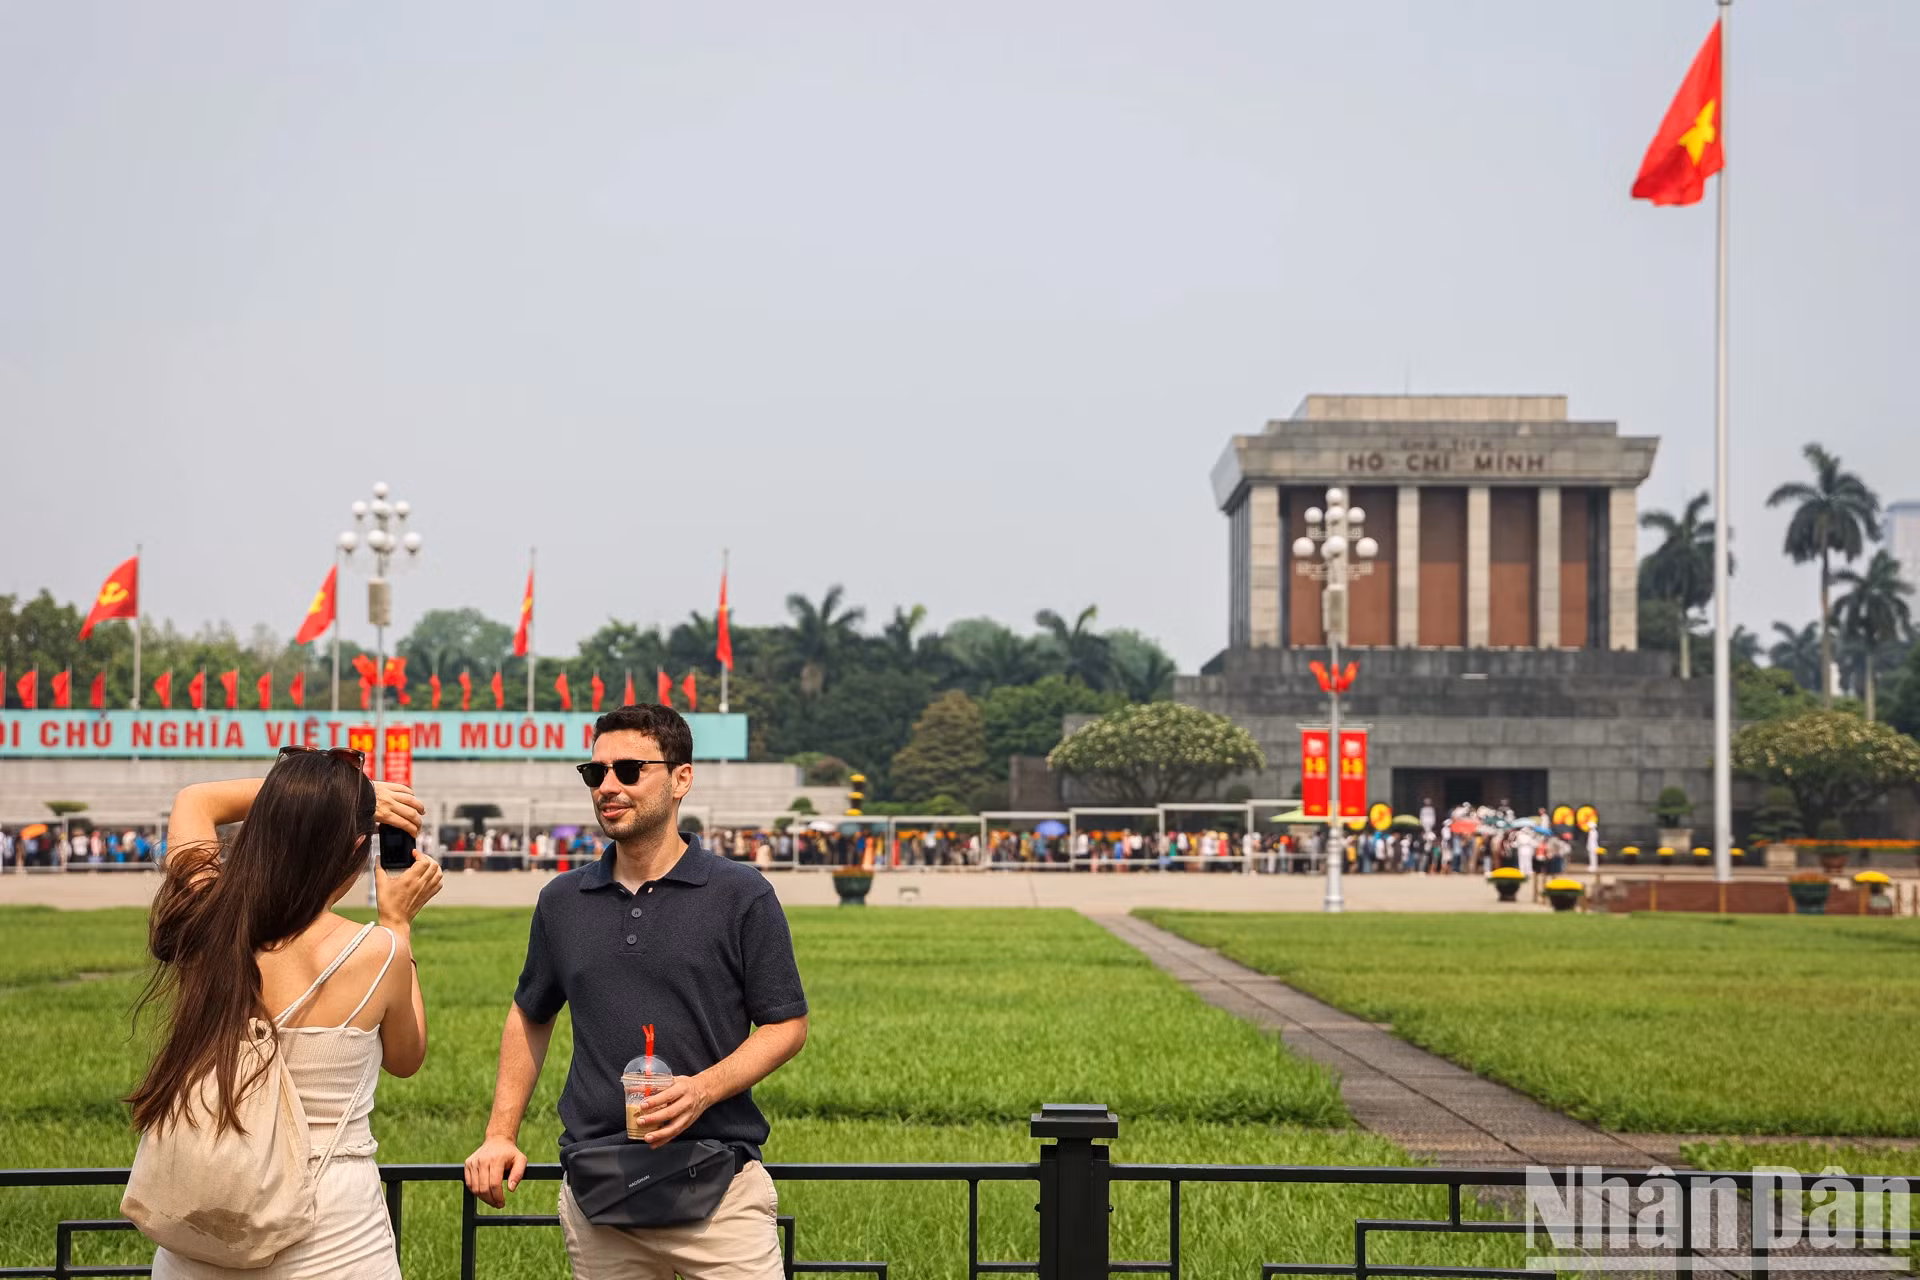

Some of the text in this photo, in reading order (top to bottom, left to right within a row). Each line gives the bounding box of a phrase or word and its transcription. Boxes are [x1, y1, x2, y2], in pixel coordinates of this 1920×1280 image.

[1474, 454, 1545, 472] MINH
[131, 716, 244, 749] NGHĨA
[460, 717, 565, 749] MUÔN
